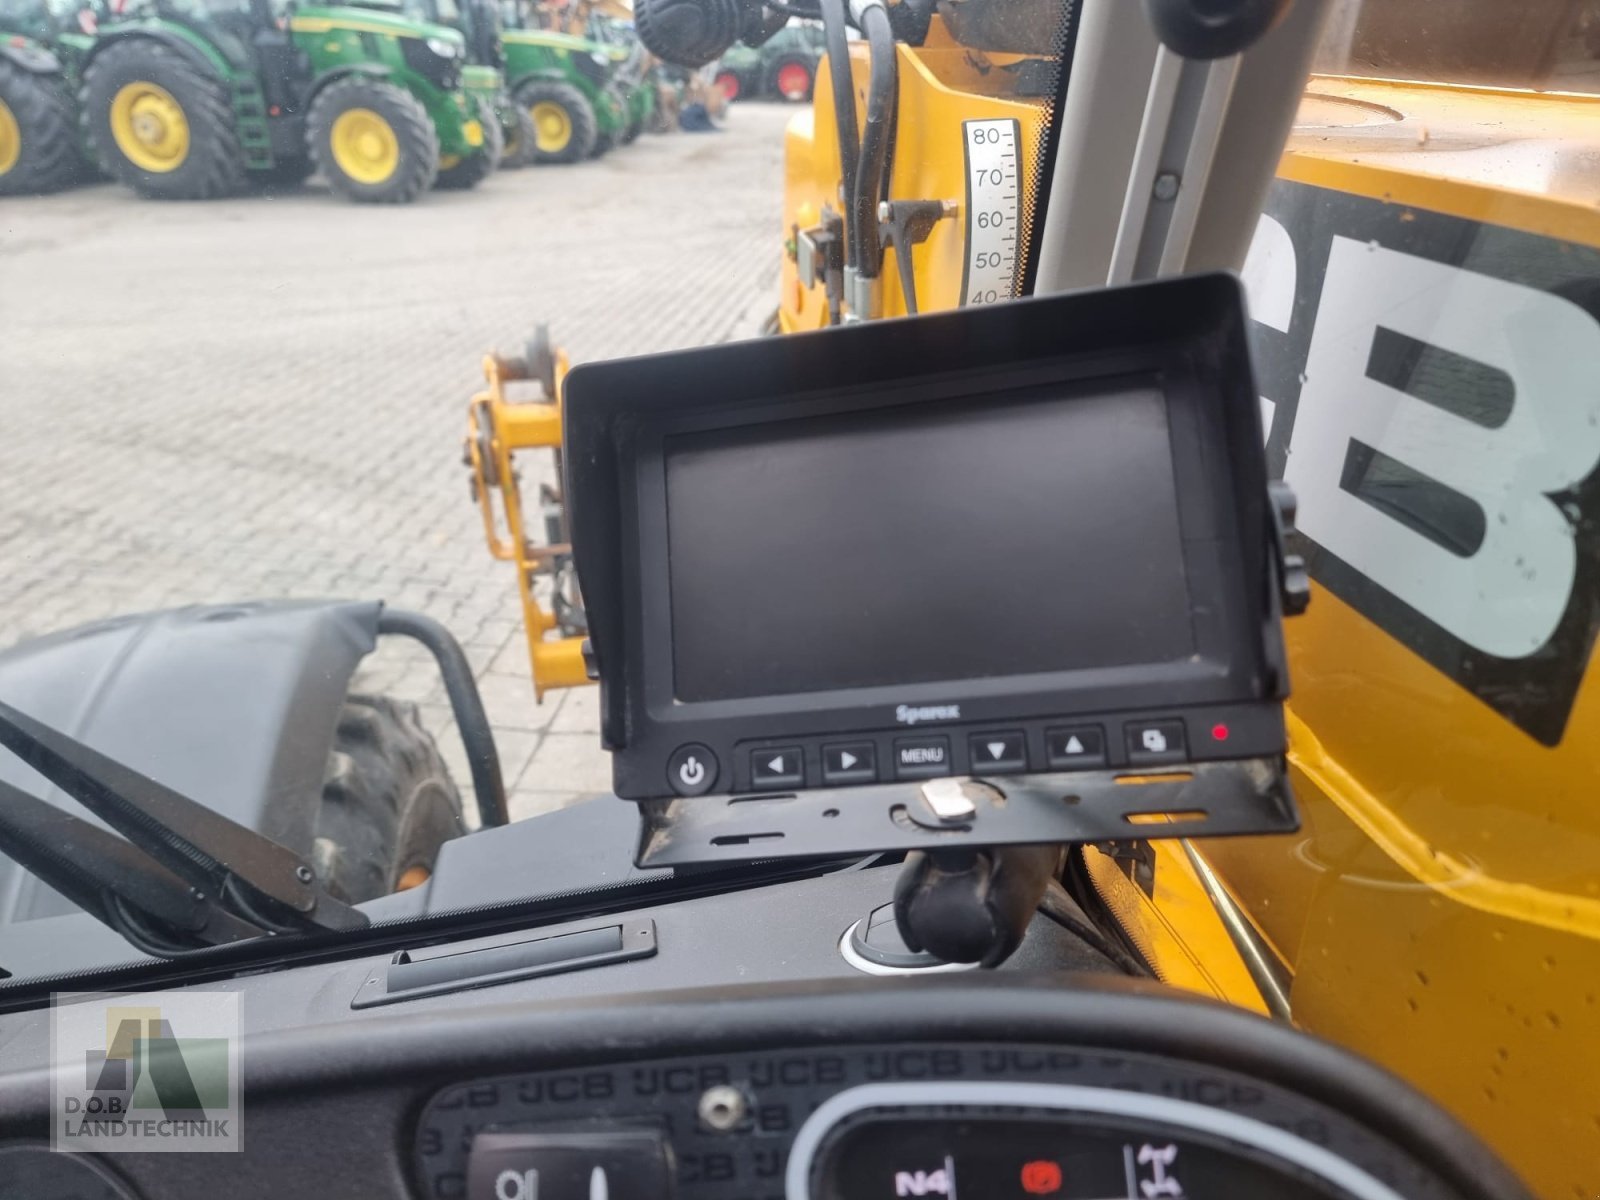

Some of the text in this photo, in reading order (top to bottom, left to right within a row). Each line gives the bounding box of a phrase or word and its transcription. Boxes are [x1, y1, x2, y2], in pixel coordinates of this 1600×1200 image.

[973, 128, 999, 145] 80
[976, 169, 1002, 187] 70
[977, 211, 1003, 228] 60
[975, 252, 1001, 269] 50
[971, 290, 997, 304] 40
[895, 704, 961, 725] Sparex
[901, 747, 943, 763] MENU
[517, 1072, 614, 1103] JCB
[749, 1056, 844, 1086] JCB
[864, 1050, 964, 1080] JCB
[895, 1171, 948, 1196] N4
